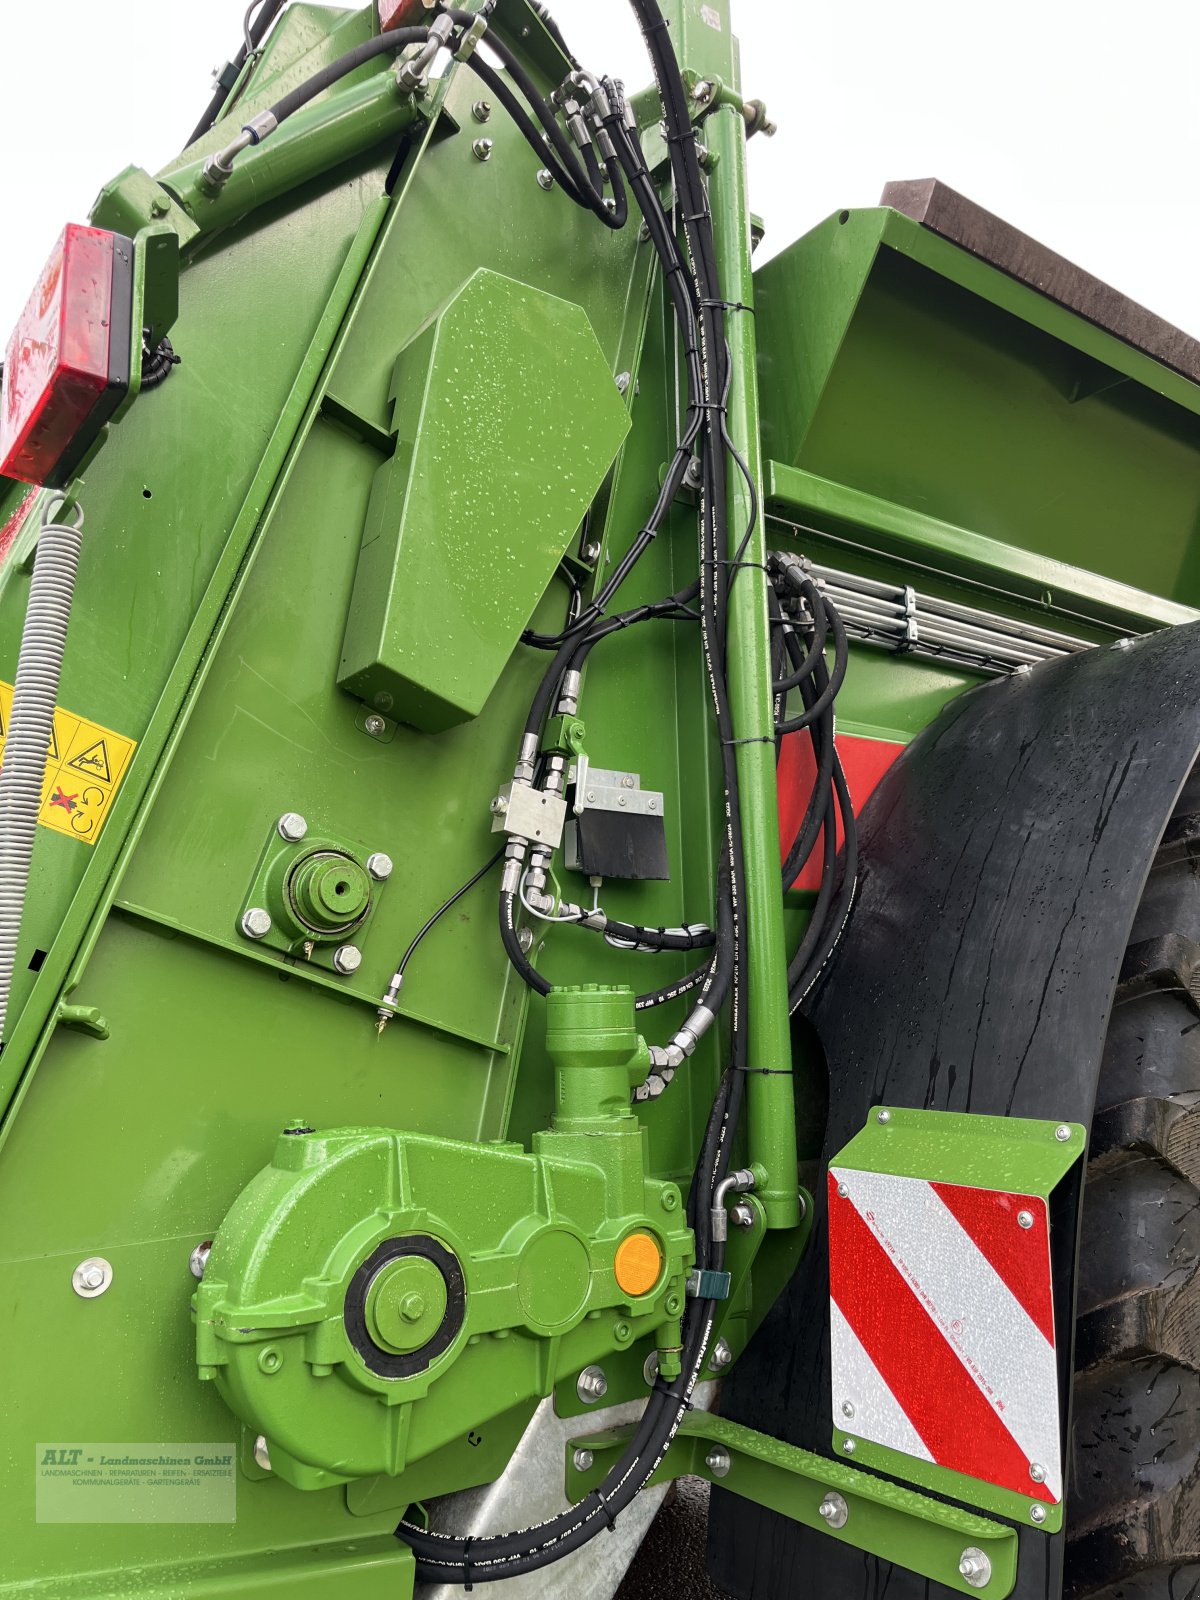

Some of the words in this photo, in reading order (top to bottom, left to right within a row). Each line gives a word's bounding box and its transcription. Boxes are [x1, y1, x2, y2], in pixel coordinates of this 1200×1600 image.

[732, 896, 738, 907] WP
[669, 1422, 679, 1439] 2SC
[662, 1442, 670, 1451] 10
